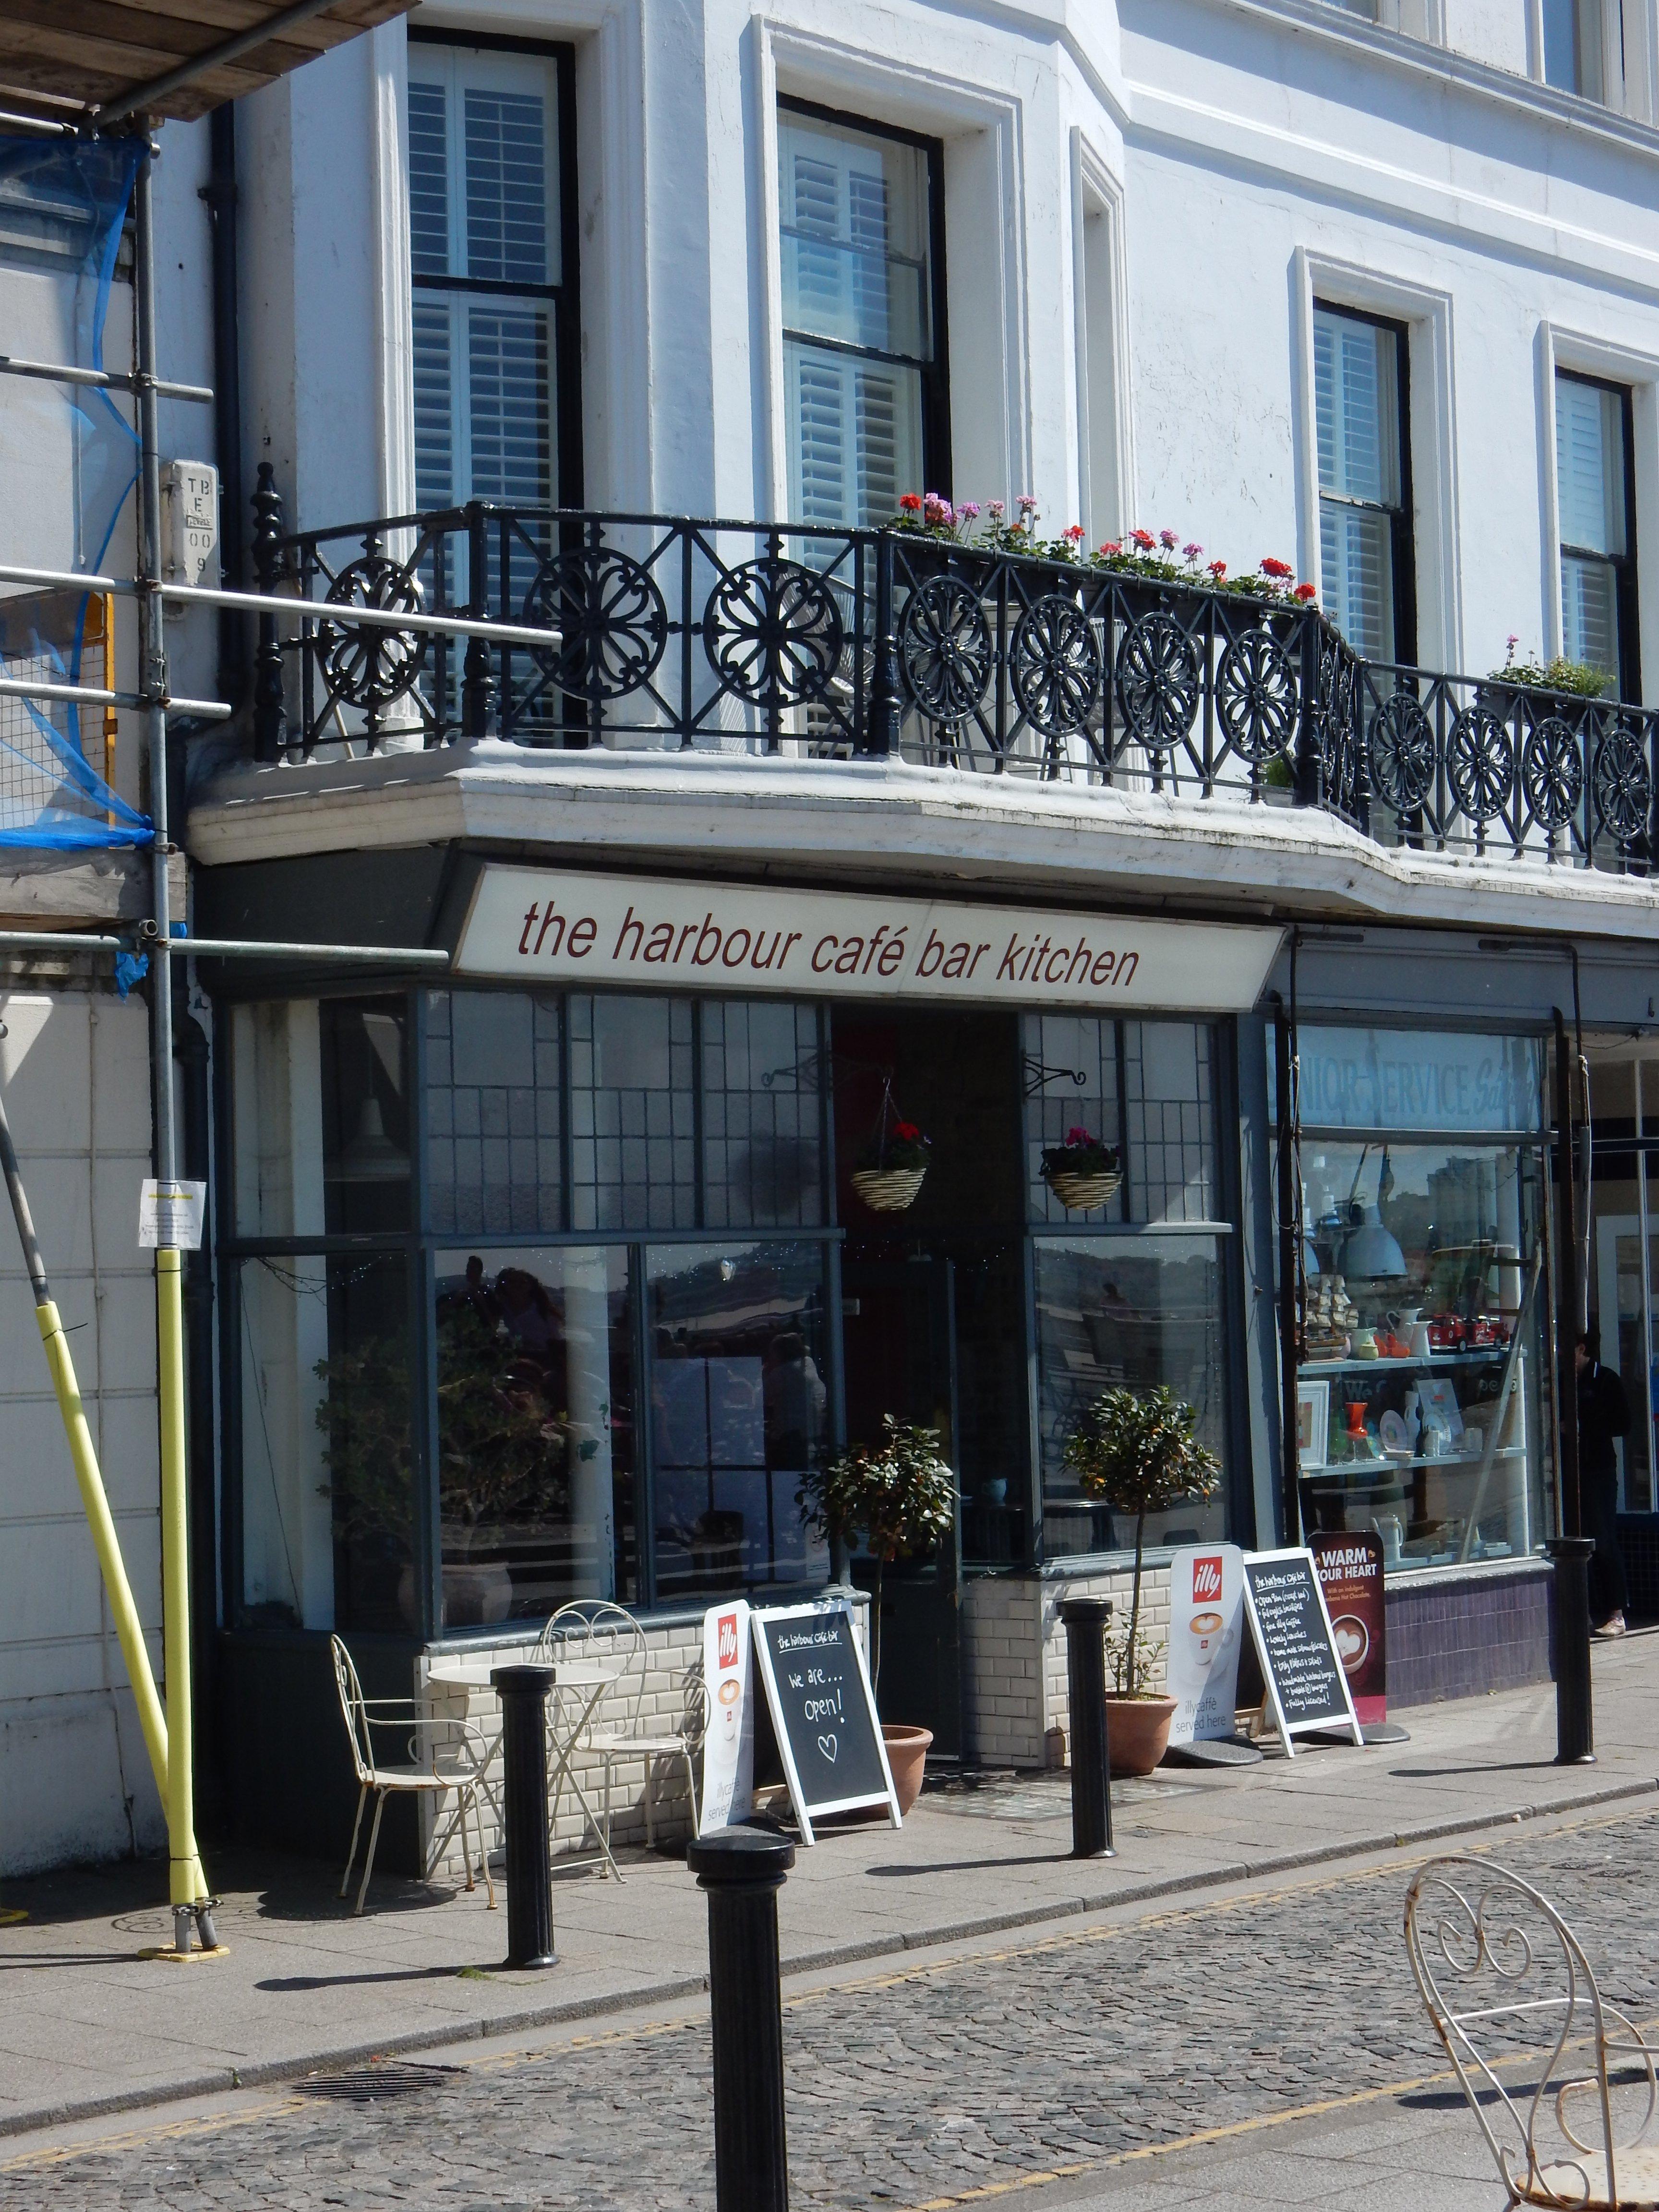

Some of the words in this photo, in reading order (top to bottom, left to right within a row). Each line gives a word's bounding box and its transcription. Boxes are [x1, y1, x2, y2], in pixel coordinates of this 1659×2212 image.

[194, 497, 203, 512] E
[197, 557, 206, 572] 9
[518, 901, 597, 958] the
[612, 906, 802, 969] harbour
[810, 925, 908, 976] café
[915, 928, 991, 979] bar
[996, 933, 1139, 986] kitchen
[1321, 1547, 1367, 1567] WARM
[1345, 1563, 1377, 1579] HEART
[1194, 1563, 1221, 1598] illy
[720, 1623, 736, 1662] illy
[778, 1634, 791, 1649] the
[788, 1673, 804, 1689] We
[1176, 1716, 1204, 1733] served
[1207, 1714, 1226, 1728] here
